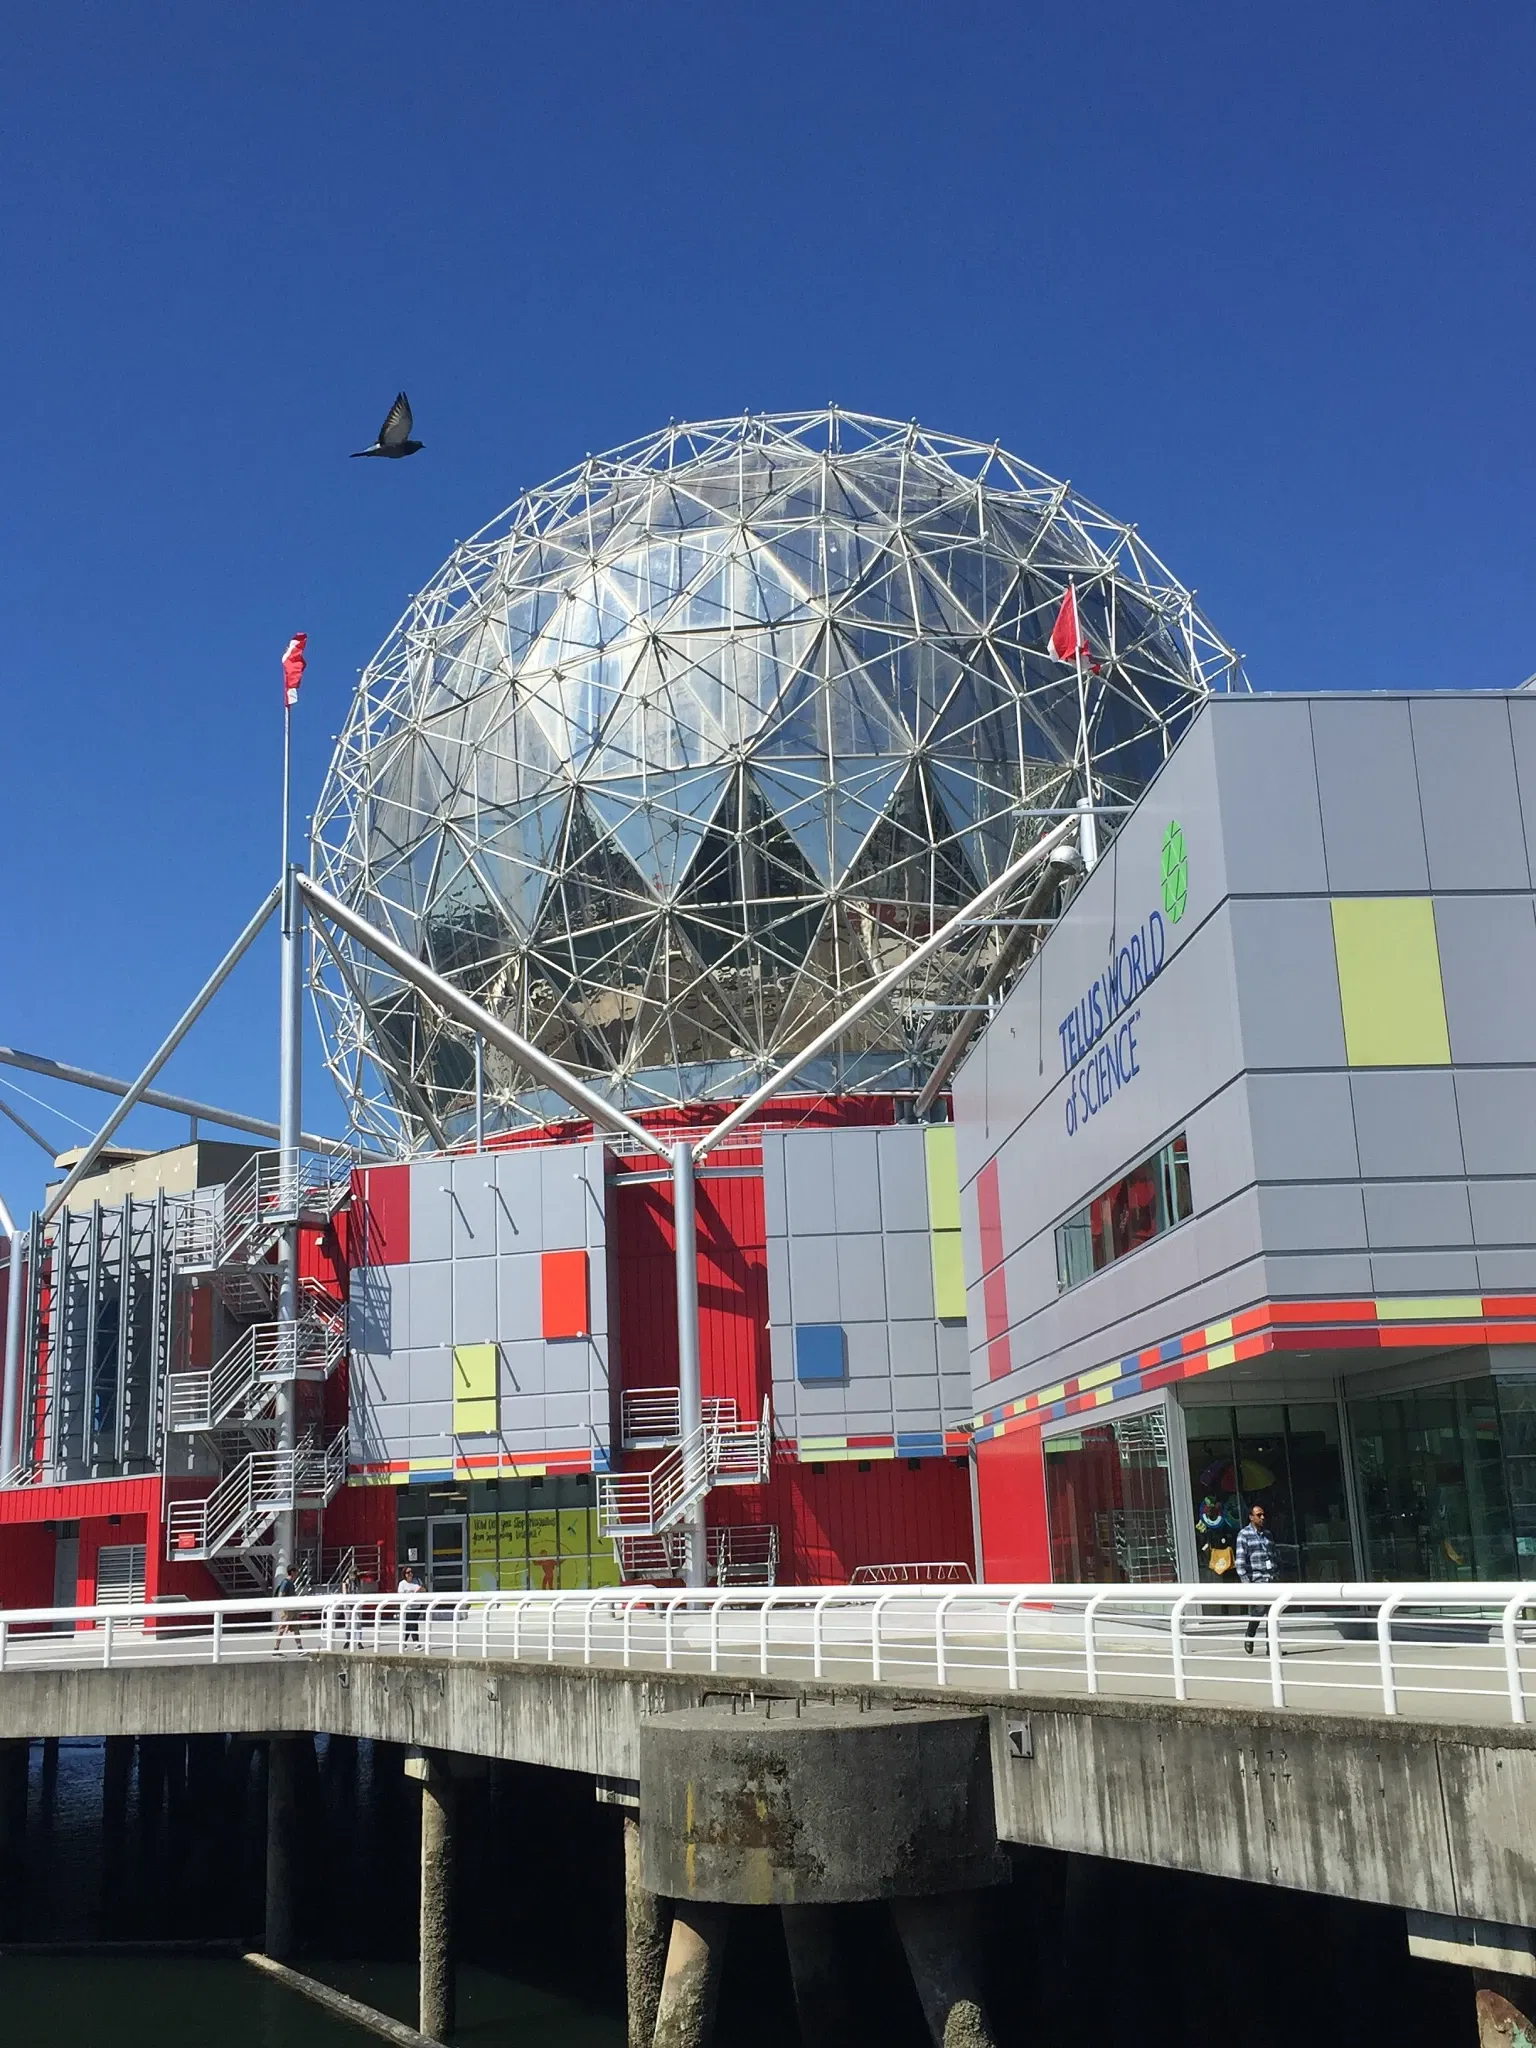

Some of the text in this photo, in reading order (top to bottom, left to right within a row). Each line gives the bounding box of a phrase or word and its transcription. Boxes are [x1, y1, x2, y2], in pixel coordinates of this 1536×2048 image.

[1058, 910, 1165, 1074] TELUS WORLD
[1065, 1073, 1078, 1137] of
